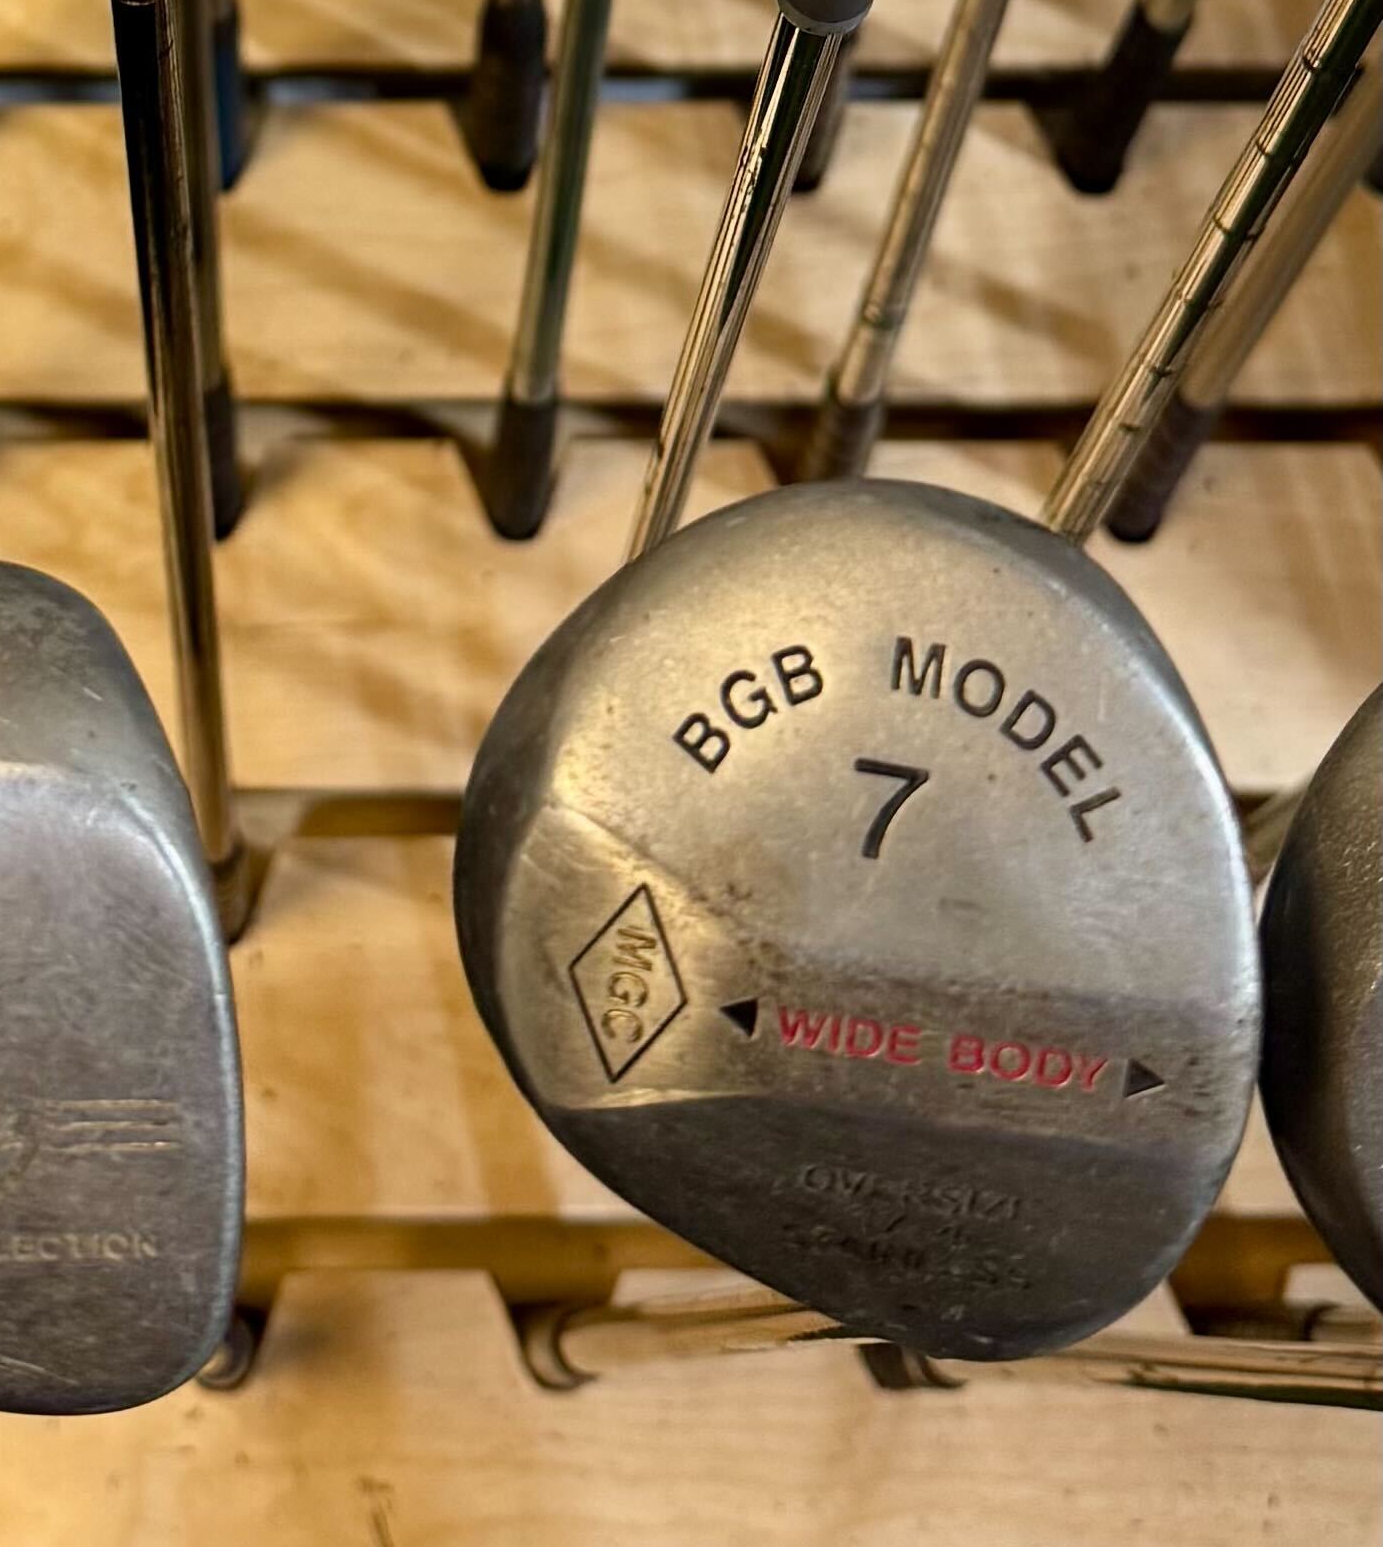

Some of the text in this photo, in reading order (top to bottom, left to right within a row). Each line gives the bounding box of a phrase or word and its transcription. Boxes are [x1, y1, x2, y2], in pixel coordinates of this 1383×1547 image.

[673, 636, 1130, 844] BGB MODEL
[853, 758, 930, 859] 7
[603, 926, 657, 1047] MGC
[777, 1005, 1111, 1093] WIDE BODY
